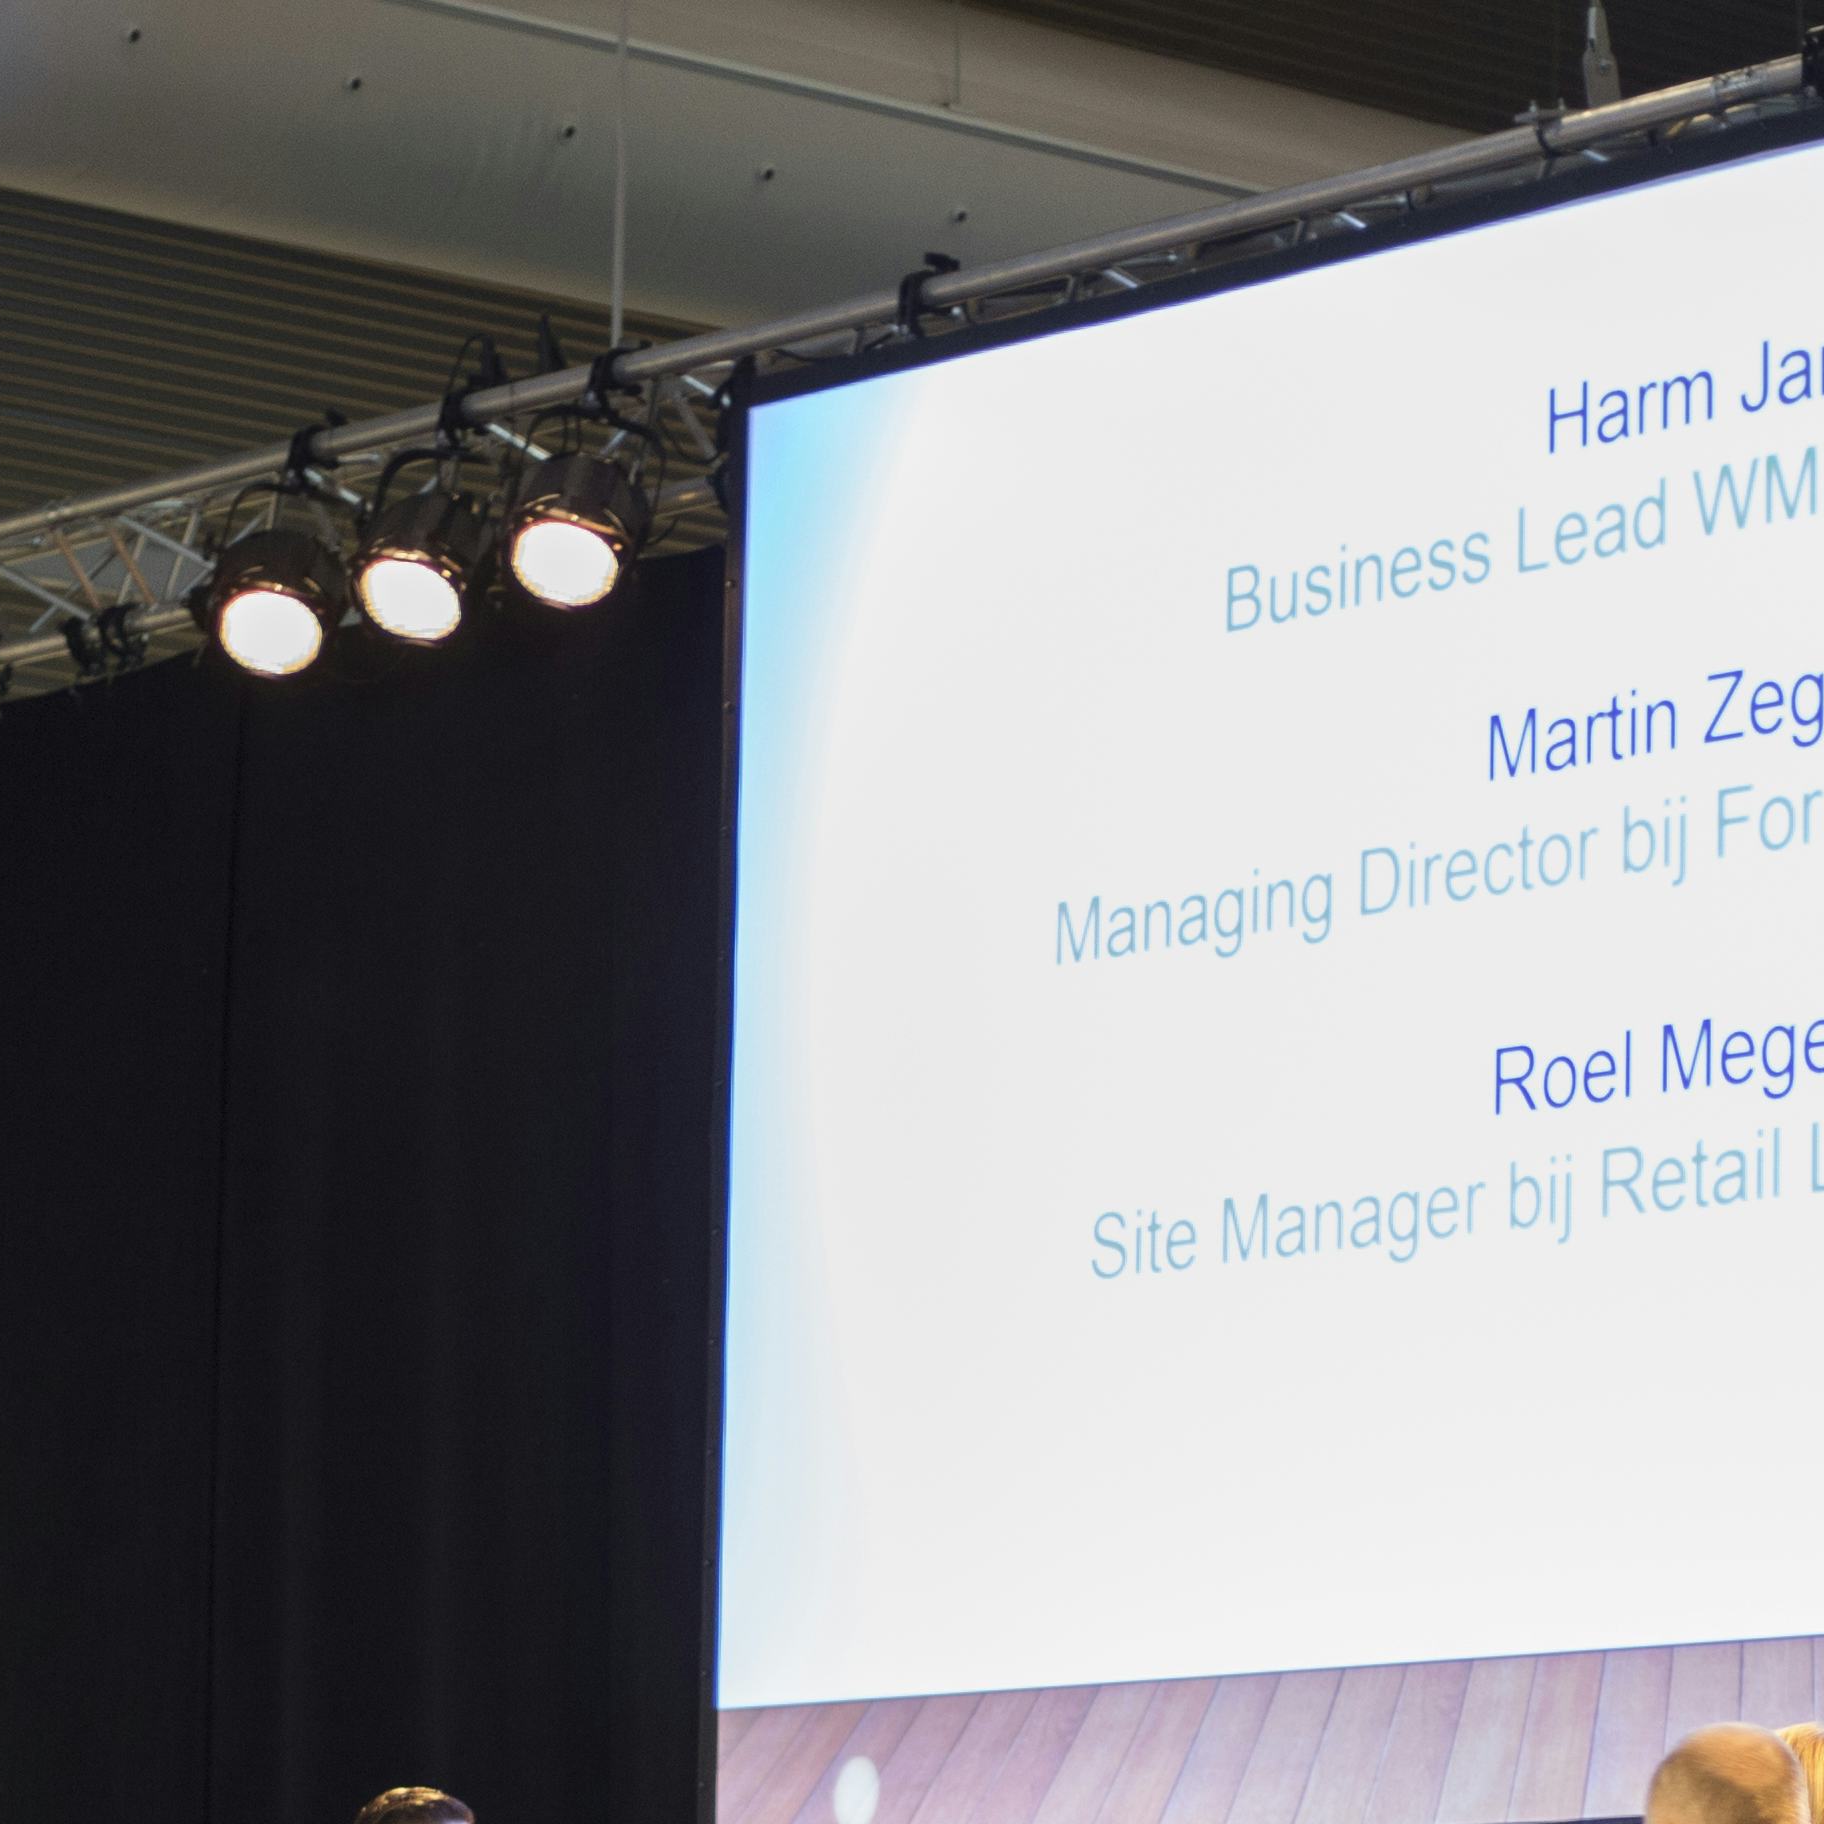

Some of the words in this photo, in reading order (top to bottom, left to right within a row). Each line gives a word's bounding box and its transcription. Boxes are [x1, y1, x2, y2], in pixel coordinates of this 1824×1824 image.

[1547, 368, 1716, 456] Harm
[1225, 530, 1492, 633] Business
[1517, 476, 1667, 574] Lead
[1487, 688, 1679, 783] Martin
[1055, 872, 1333, 966] Managing
[1359, 823, 1600, 917] Director
[1622, 797, 1688, 887] bij
[1494, 1028, 1633, 1117] Roel
[1091, 1209, 1198, 1280] Site
[1222, 1181, 1487, 1265] Manager
[1509, 1154, 1574, 1245] bij
[1601, 1126, 1781, 1218] Retail
